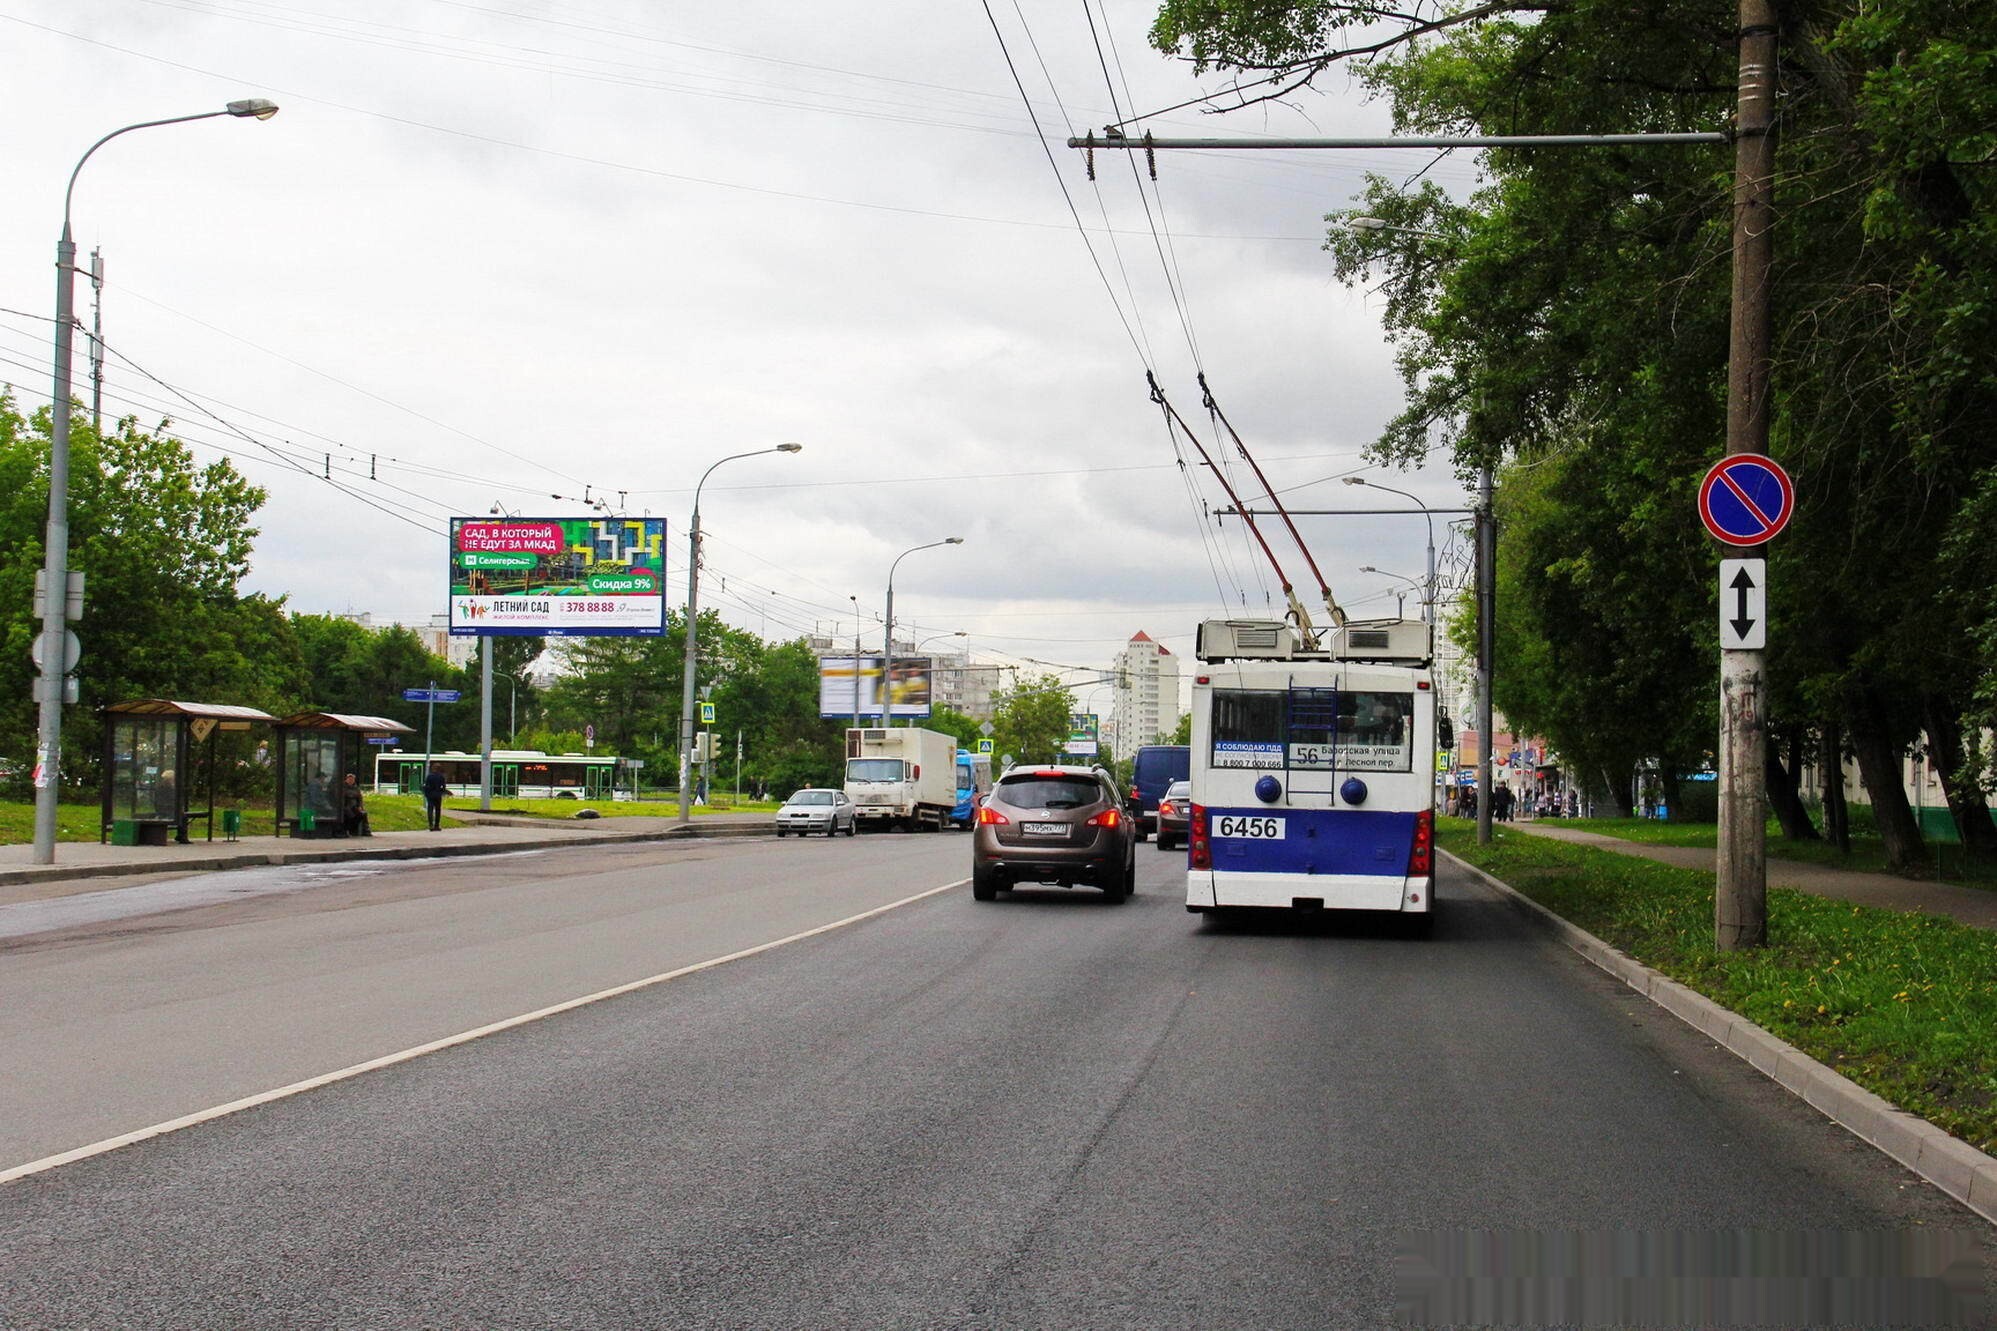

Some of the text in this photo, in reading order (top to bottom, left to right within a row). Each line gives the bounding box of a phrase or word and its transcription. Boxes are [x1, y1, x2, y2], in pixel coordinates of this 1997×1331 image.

[465, 526, 552, 539] САД, В КОТОРЫЙ
[465, 540, 556, 550] НЕ ЕДУТ ЗА МКАД
[592, 578, 651, 591] Скидка 9%
[493, 599, 528, 612] ЛЕТНИЙ
[530, 601, 550, 613] САД
[566, 602, 585, 612] 378
[1222, 743, 1265, 751] СОБЛЮДАЮ
[1266, 744, 1282, 752] ПДД
[1297, 747, 1318, 765] 56
[1220, 816, 1278, 838] 6456
